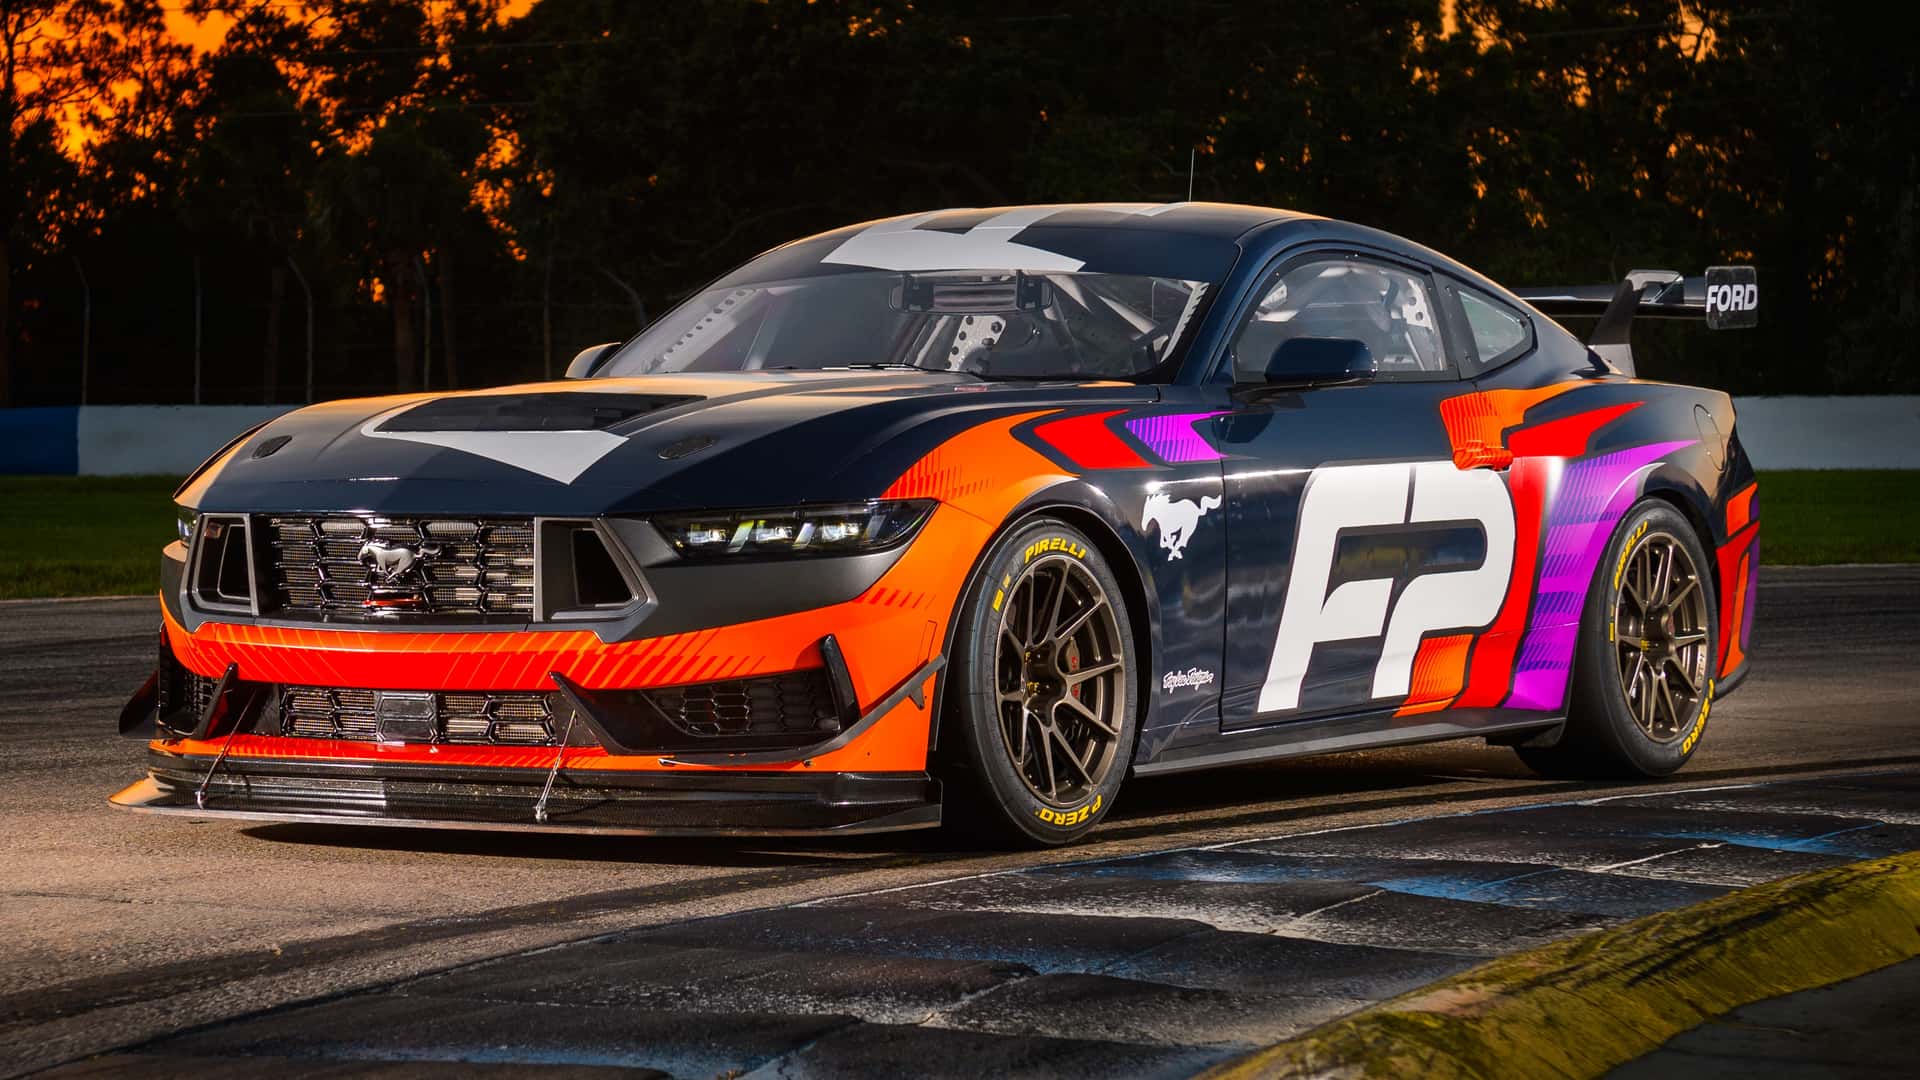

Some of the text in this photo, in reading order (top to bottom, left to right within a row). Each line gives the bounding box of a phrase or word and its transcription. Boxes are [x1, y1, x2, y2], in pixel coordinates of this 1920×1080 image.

[1706, 284, 1758, 313] FORD
[1024, 536, 1087, 564] PIRELLI
[1614, 520, 1649, 591] PIRELLI
[1258, 462, 1517, 712] FP
[1039, 794, 1103, 826] P ZERO
